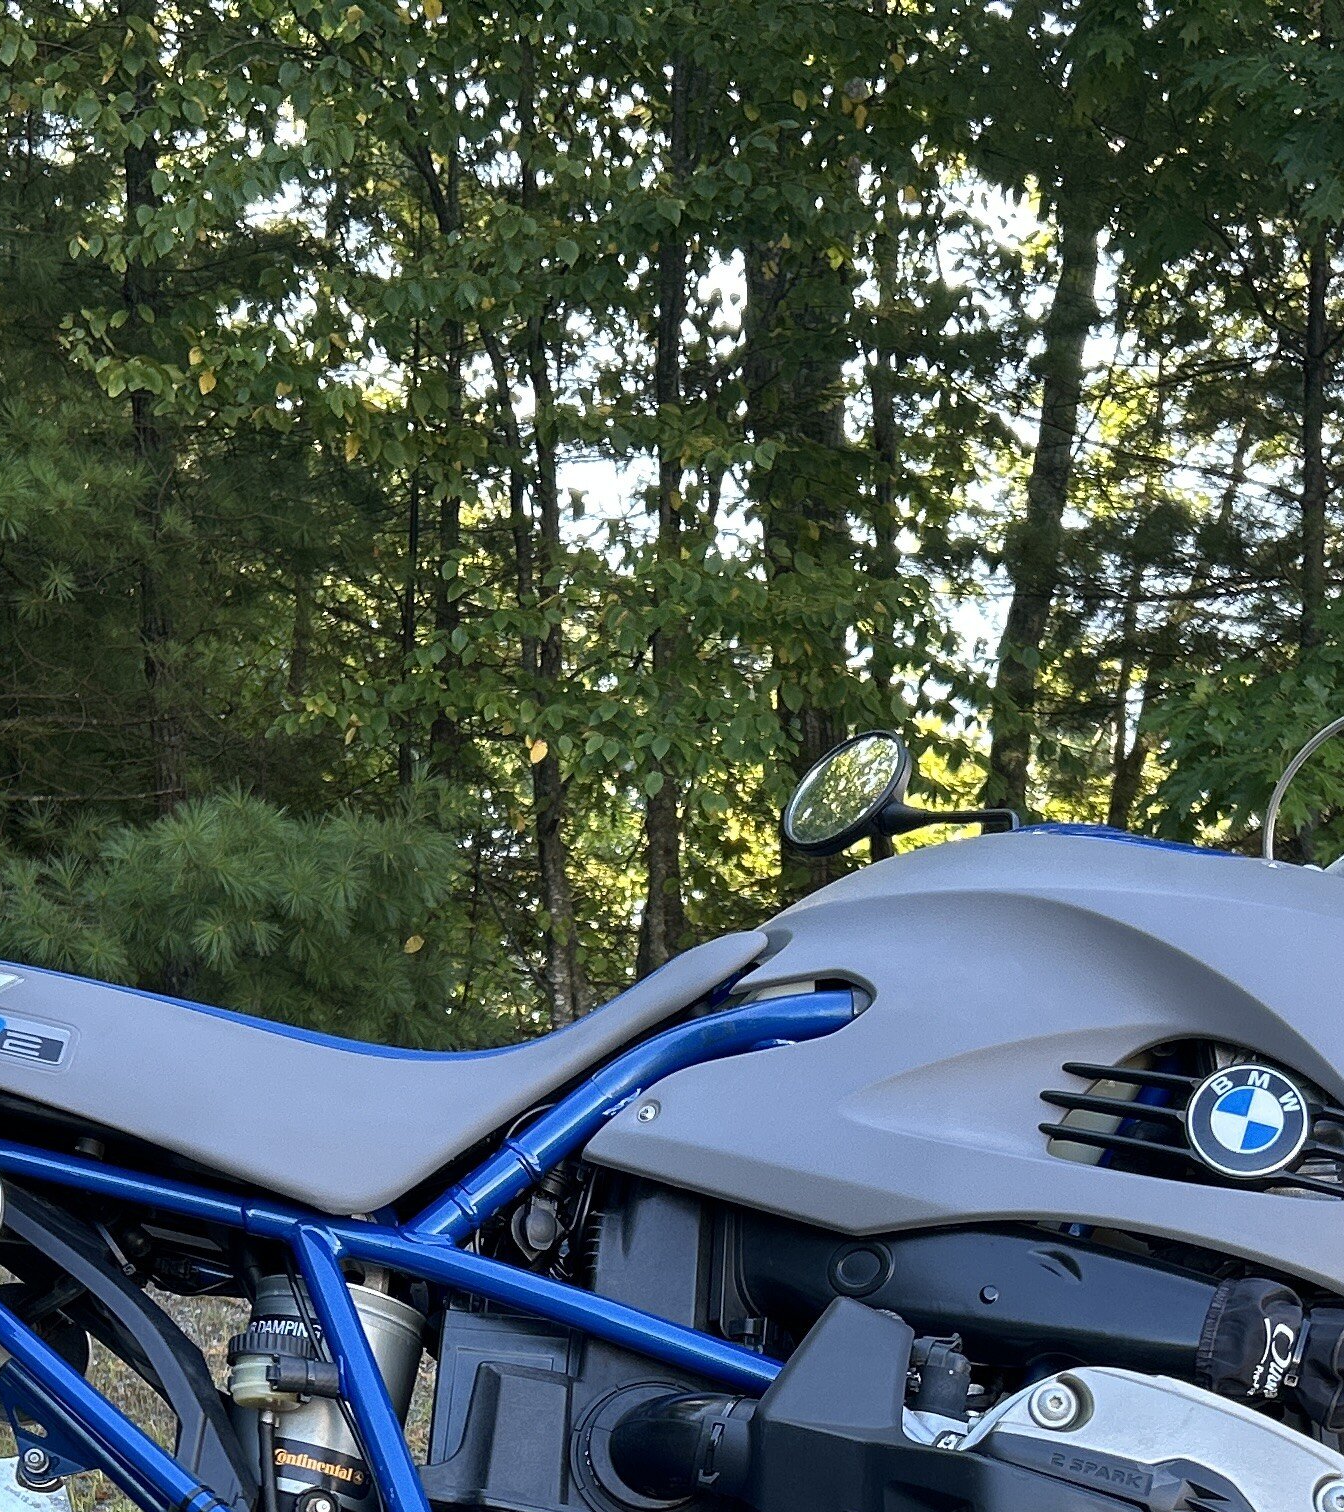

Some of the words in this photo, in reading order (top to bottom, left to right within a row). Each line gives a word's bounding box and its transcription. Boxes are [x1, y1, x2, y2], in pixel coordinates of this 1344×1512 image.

[1210, 1071, 1301, 1113] BMW
[274, 1448, 354, 1482] Continental
[1069, 1458, 1143, 1489] SPARK
